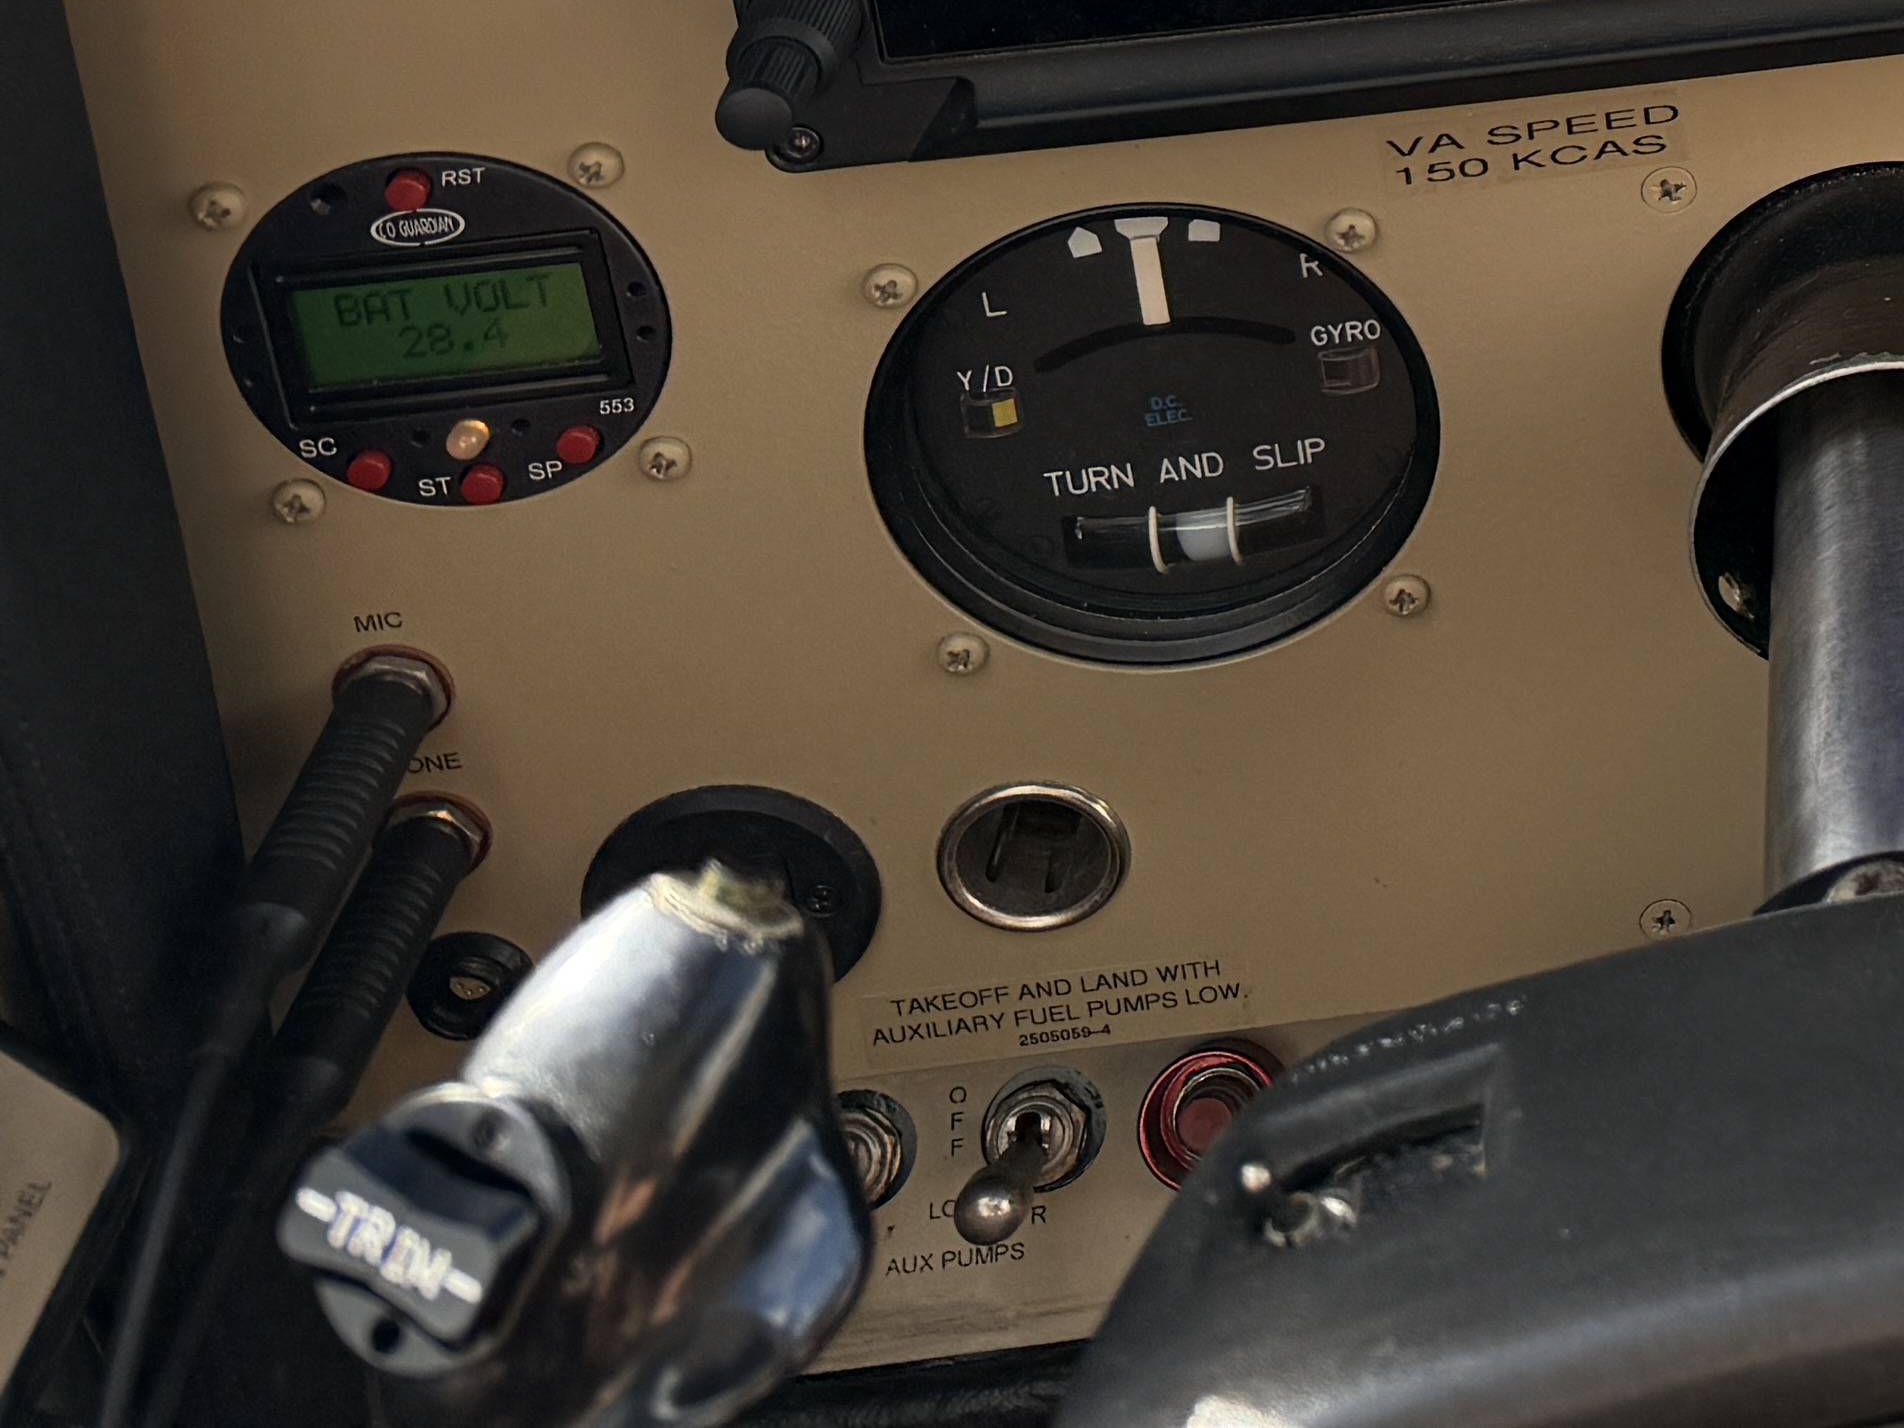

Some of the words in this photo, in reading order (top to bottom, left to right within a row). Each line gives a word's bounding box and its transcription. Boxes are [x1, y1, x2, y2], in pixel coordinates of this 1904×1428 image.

[1386, 133, 1465, 157] VA
[1487, 104, 1679, 146] SPEED
[441, 167, 485, 187] RST
[1396, 157, 1488, 185] 150
[1512, 135, 1668, 171] KCAS
[1045, 462, 1133, 497] TURN
[1159, 449, 1224, 483] AND
[1252, 438, 1327, 472] SLIP
[891, 986, 1009, 1016] TAKEOFF
[1018, 978, 1072, 1001] AND
[1080, 969, 1148, 992] LAND
[1155, 960, 1220, 982] WITH
[872, 1012, 1006, 1046] AUXILIARY
[1014, 1005, 1080, 1028] FUEL
[1088, 991, 1178, 1018] PUMPS
